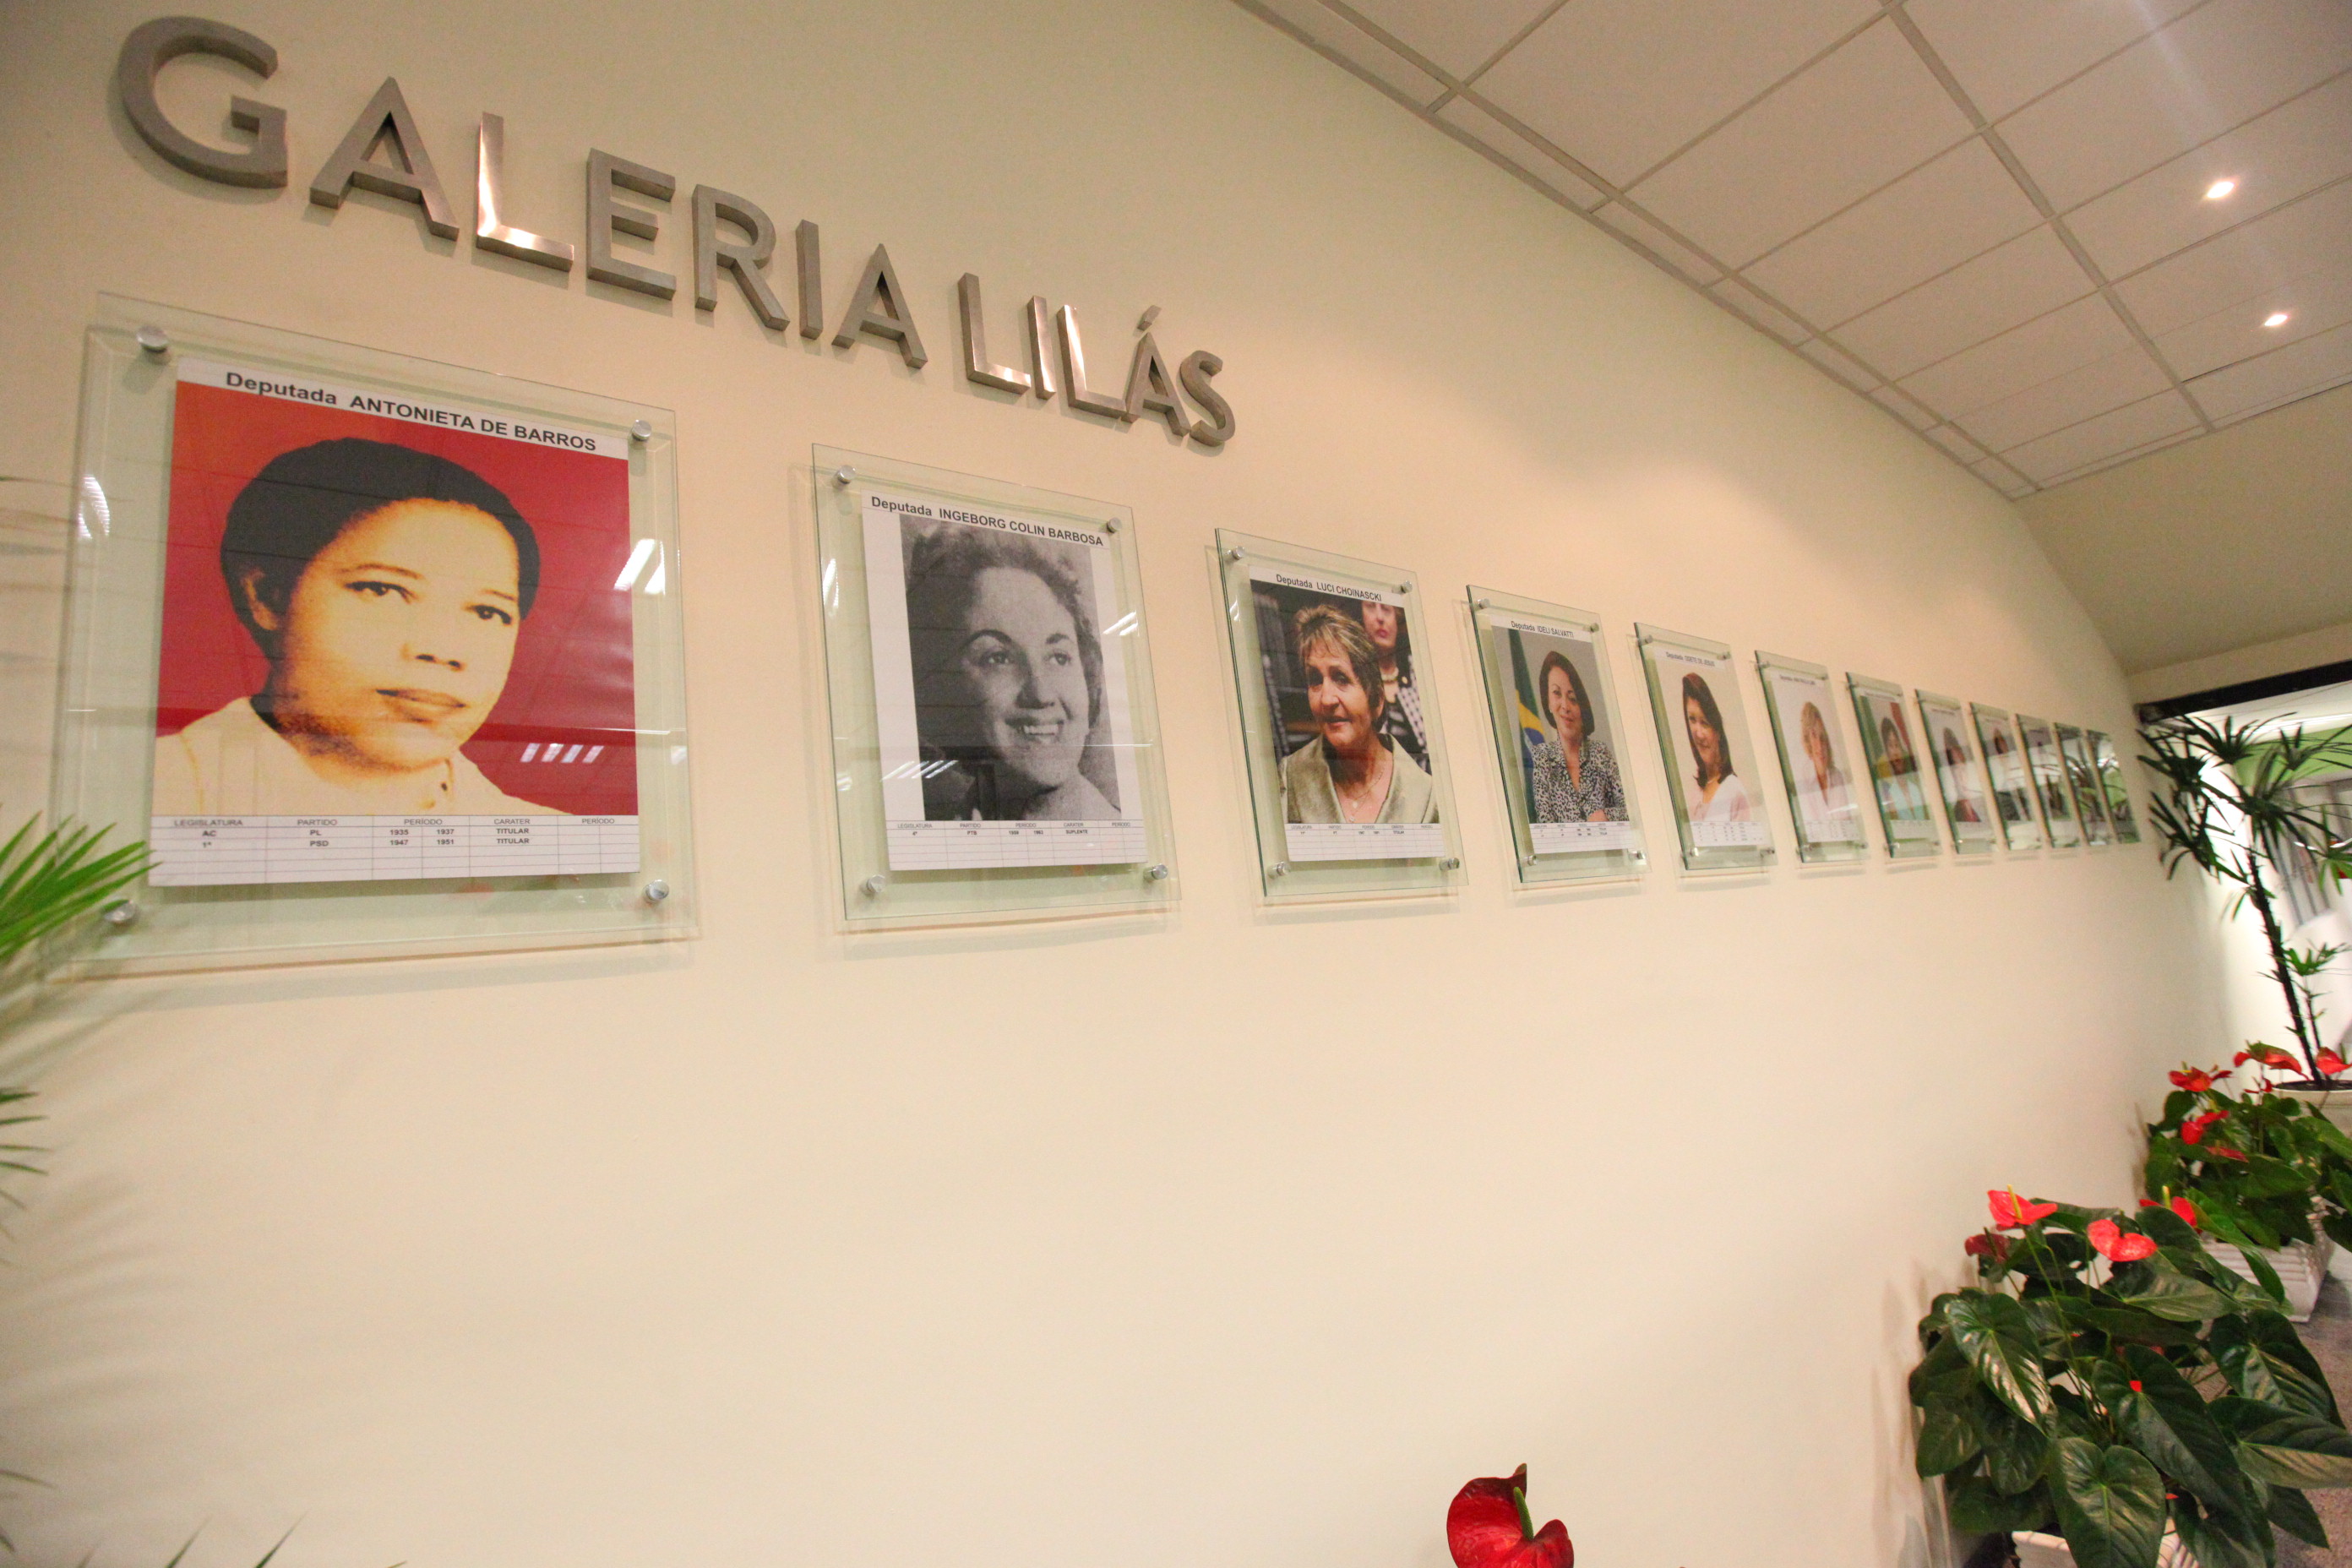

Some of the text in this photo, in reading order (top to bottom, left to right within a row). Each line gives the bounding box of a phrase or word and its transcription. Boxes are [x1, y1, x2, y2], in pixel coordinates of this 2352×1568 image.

[117, 15, 1236, 447] GALERIA LILÁS
[226, 372, 596, 451] Deputada ANTONIETA DE BARROS
[871, 495, 1103, 547] Deputada INGEBORG COLIN BARBOSA
[1276, 574, 1382, 602] Deputada LUCI CHOINASCKI
[174, 819, 243, 827] LEGISLATURA
[309, 839, 329, 847] PSD
